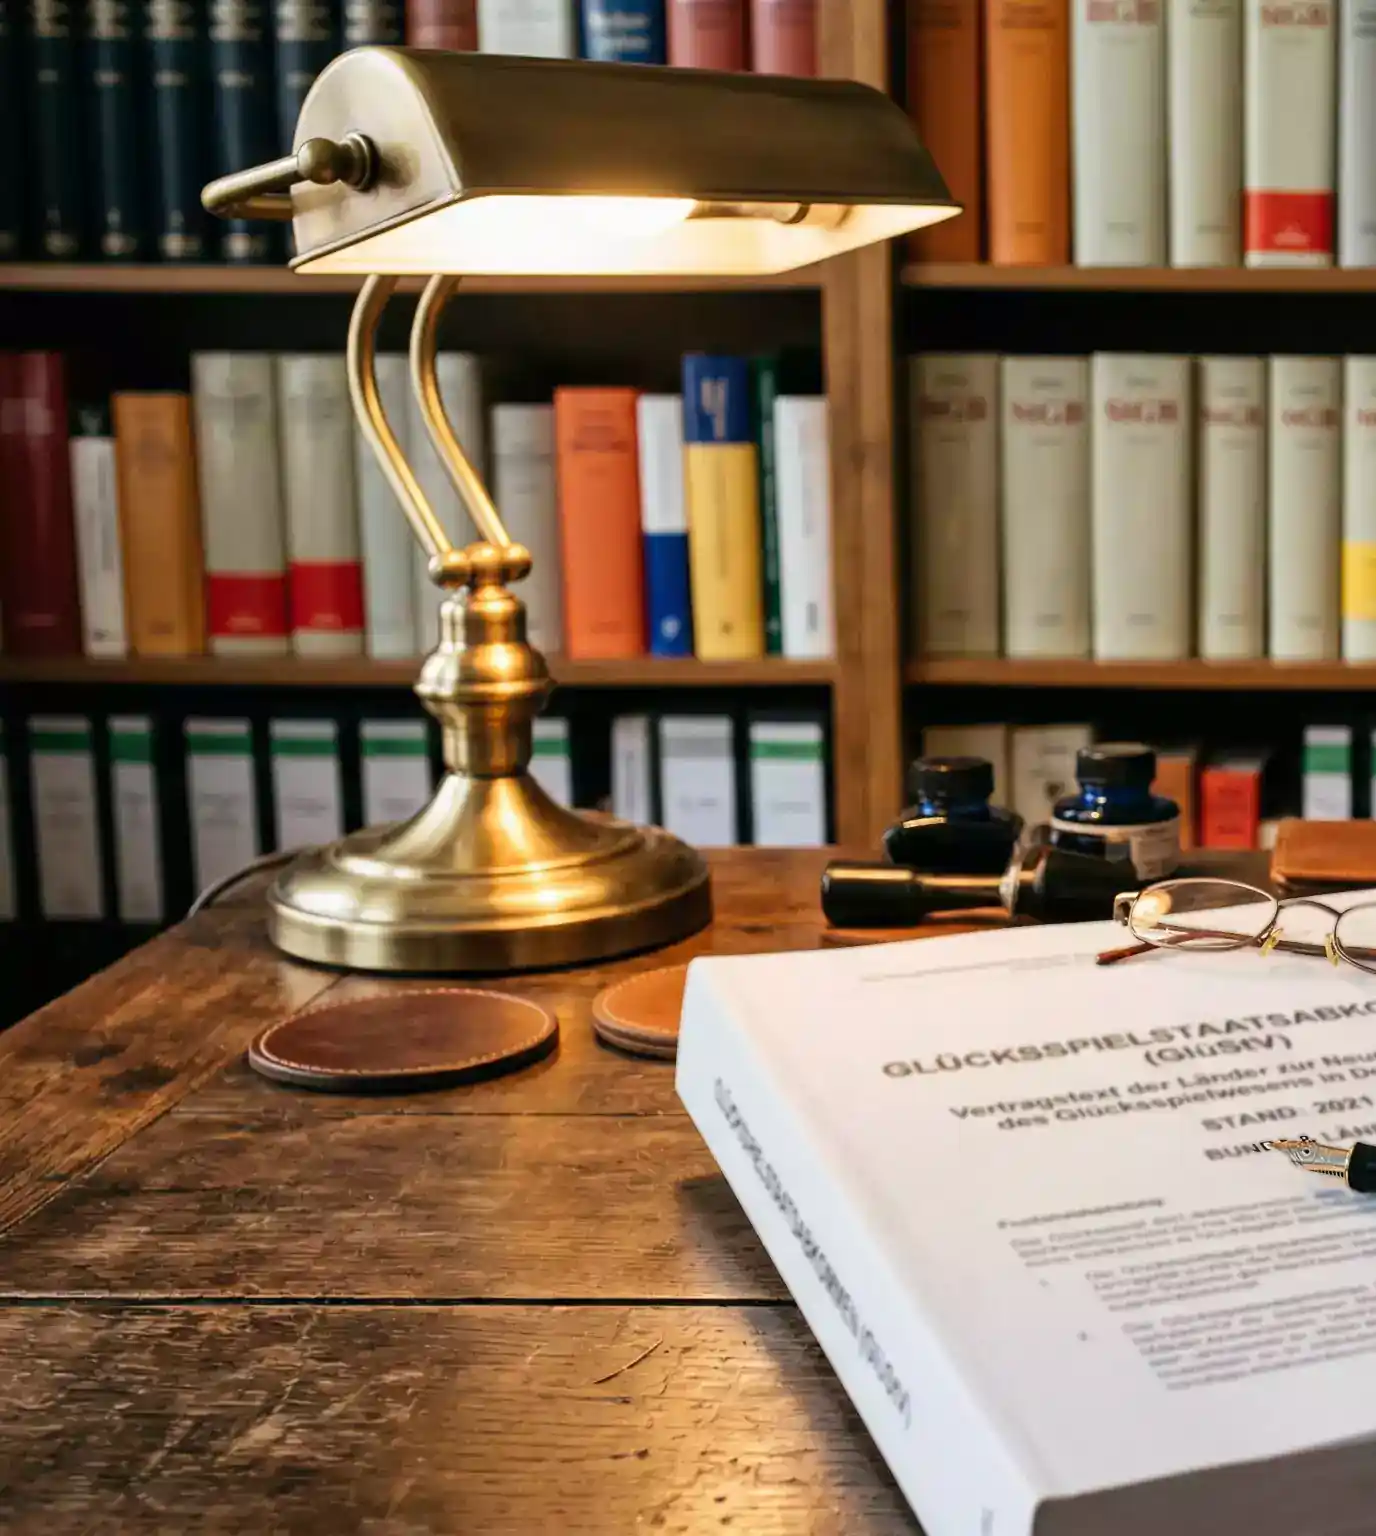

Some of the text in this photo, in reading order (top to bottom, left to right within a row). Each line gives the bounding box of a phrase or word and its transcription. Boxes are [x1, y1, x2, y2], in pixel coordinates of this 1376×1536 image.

[949, 1086, 1120, 1119] Vertragstext
[1128, 1080, 1171, 1096] der
[1177, 1066, 1268, 1089] Länder
[1277, 1061, 1316, 1076] zur
[998, 1117, 1050, 1130] des
[1055, 1077, 1314, 1123] Glücksspielwesens
[1317, 1071, 1347, 1084] in
[1313, 1095, 1375, 1115] 2021
